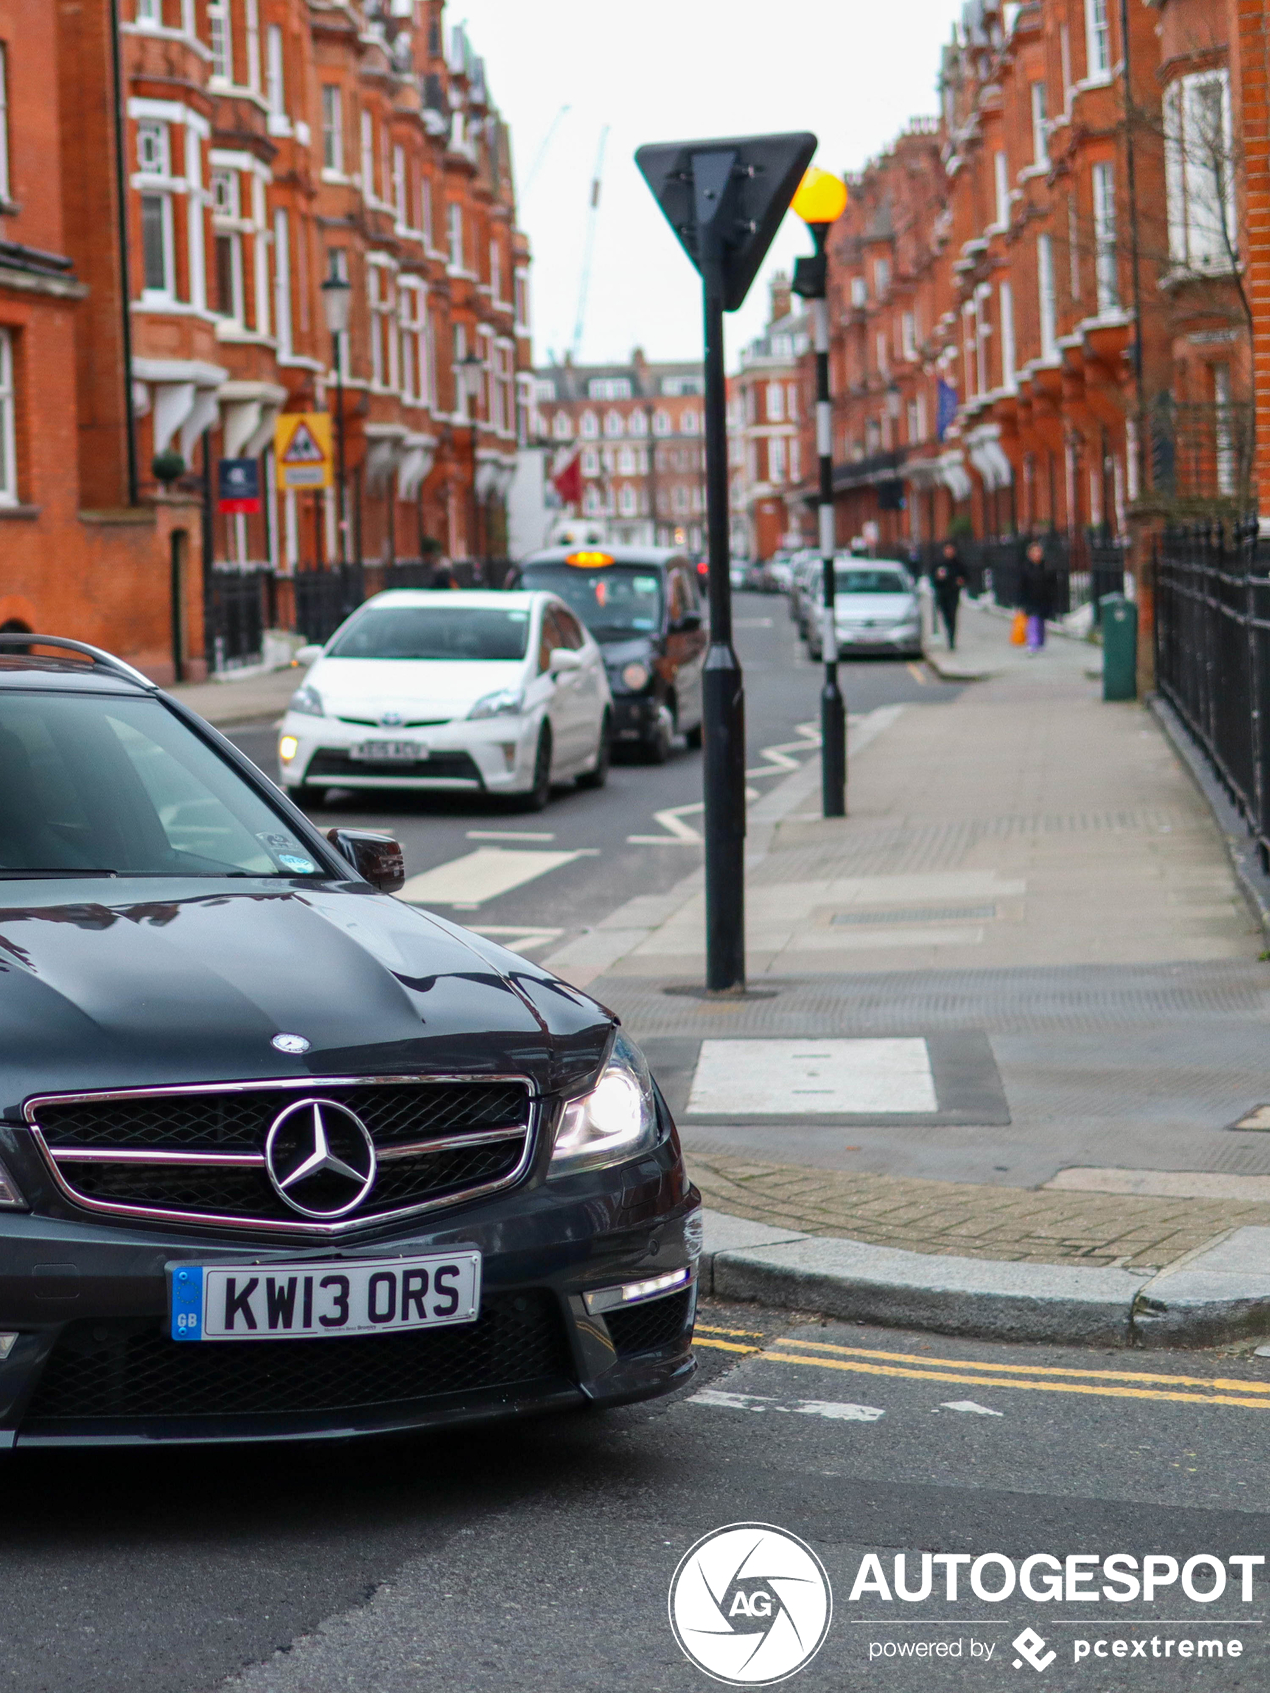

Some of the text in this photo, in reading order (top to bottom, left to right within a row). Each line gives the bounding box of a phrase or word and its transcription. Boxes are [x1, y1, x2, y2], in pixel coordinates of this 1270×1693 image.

[225, 1265, 460, 1330] KW13 ORS
[177, 1313, 197, 1328] GB
